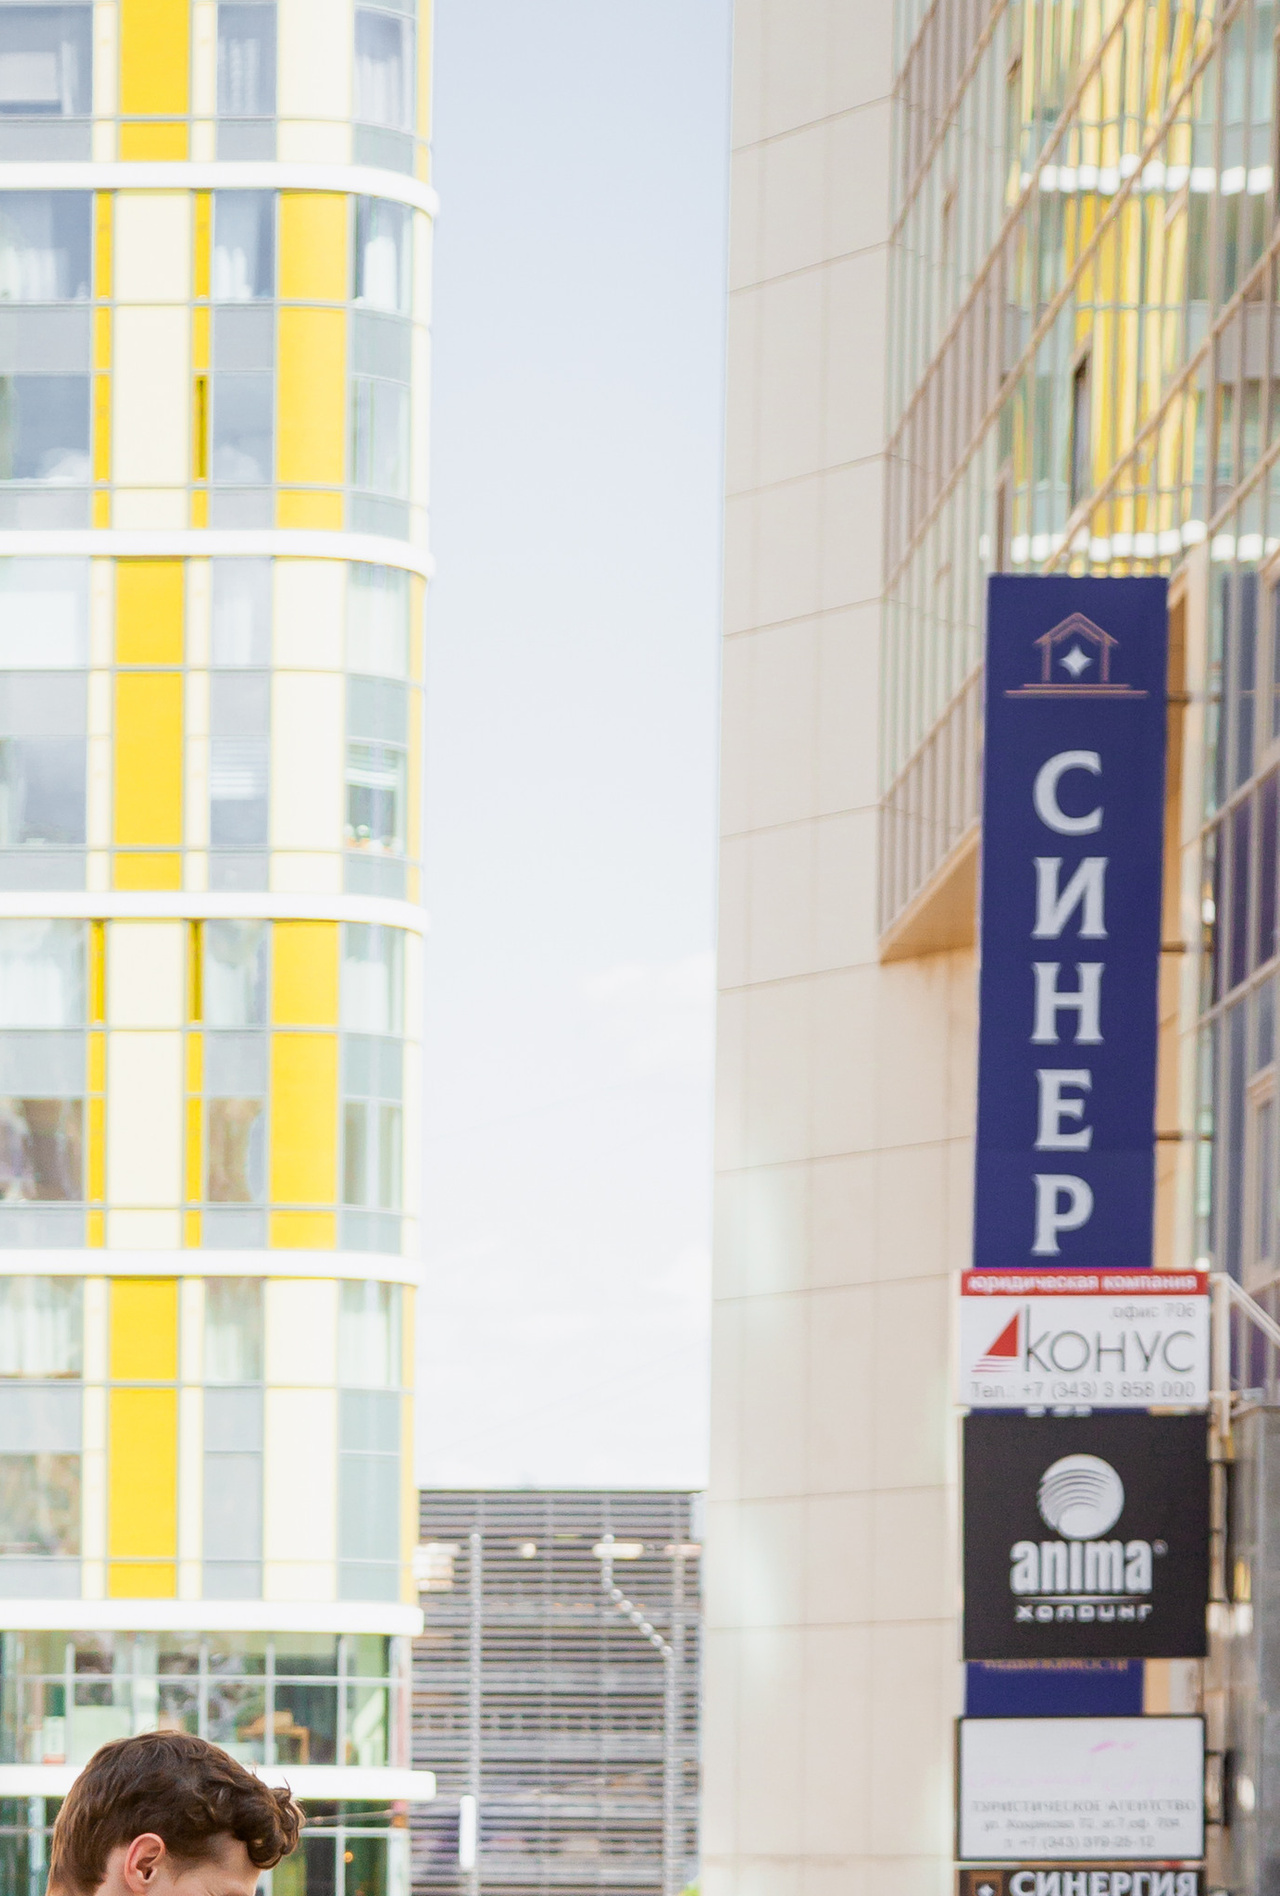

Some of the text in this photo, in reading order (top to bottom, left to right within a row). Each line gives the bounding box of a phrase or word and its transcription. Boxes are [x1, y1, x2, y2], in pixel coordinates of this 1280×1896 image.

[1102, 1275, 1197, 1292] компания
[1024, 1304, 1195, 1374] КОНУС
[1022, 1381, 1044, 1397] +7
[1051, 1380, 1097, 1400] (343)
[1161, 1381, 1195, 1398] 000
[1108, 1799, 1197, 1812] АГЕНТСТВО
